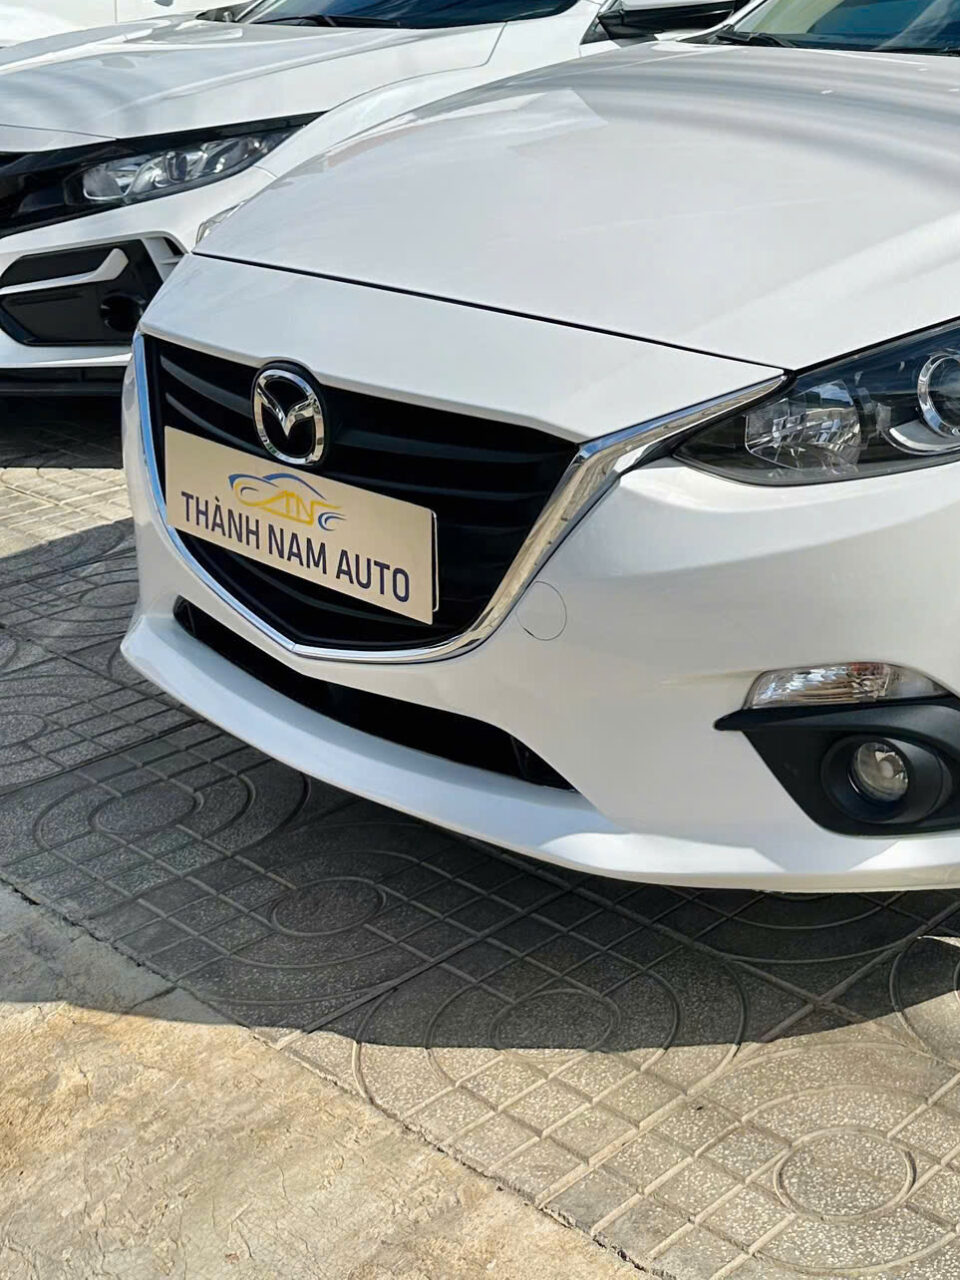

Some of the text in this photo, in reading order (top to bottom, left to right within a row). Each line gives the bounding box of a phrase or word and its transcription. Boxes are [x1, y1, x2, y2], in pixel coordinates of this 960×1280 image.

[181, 491, 411, 603] THÀNH NAM AUTO
